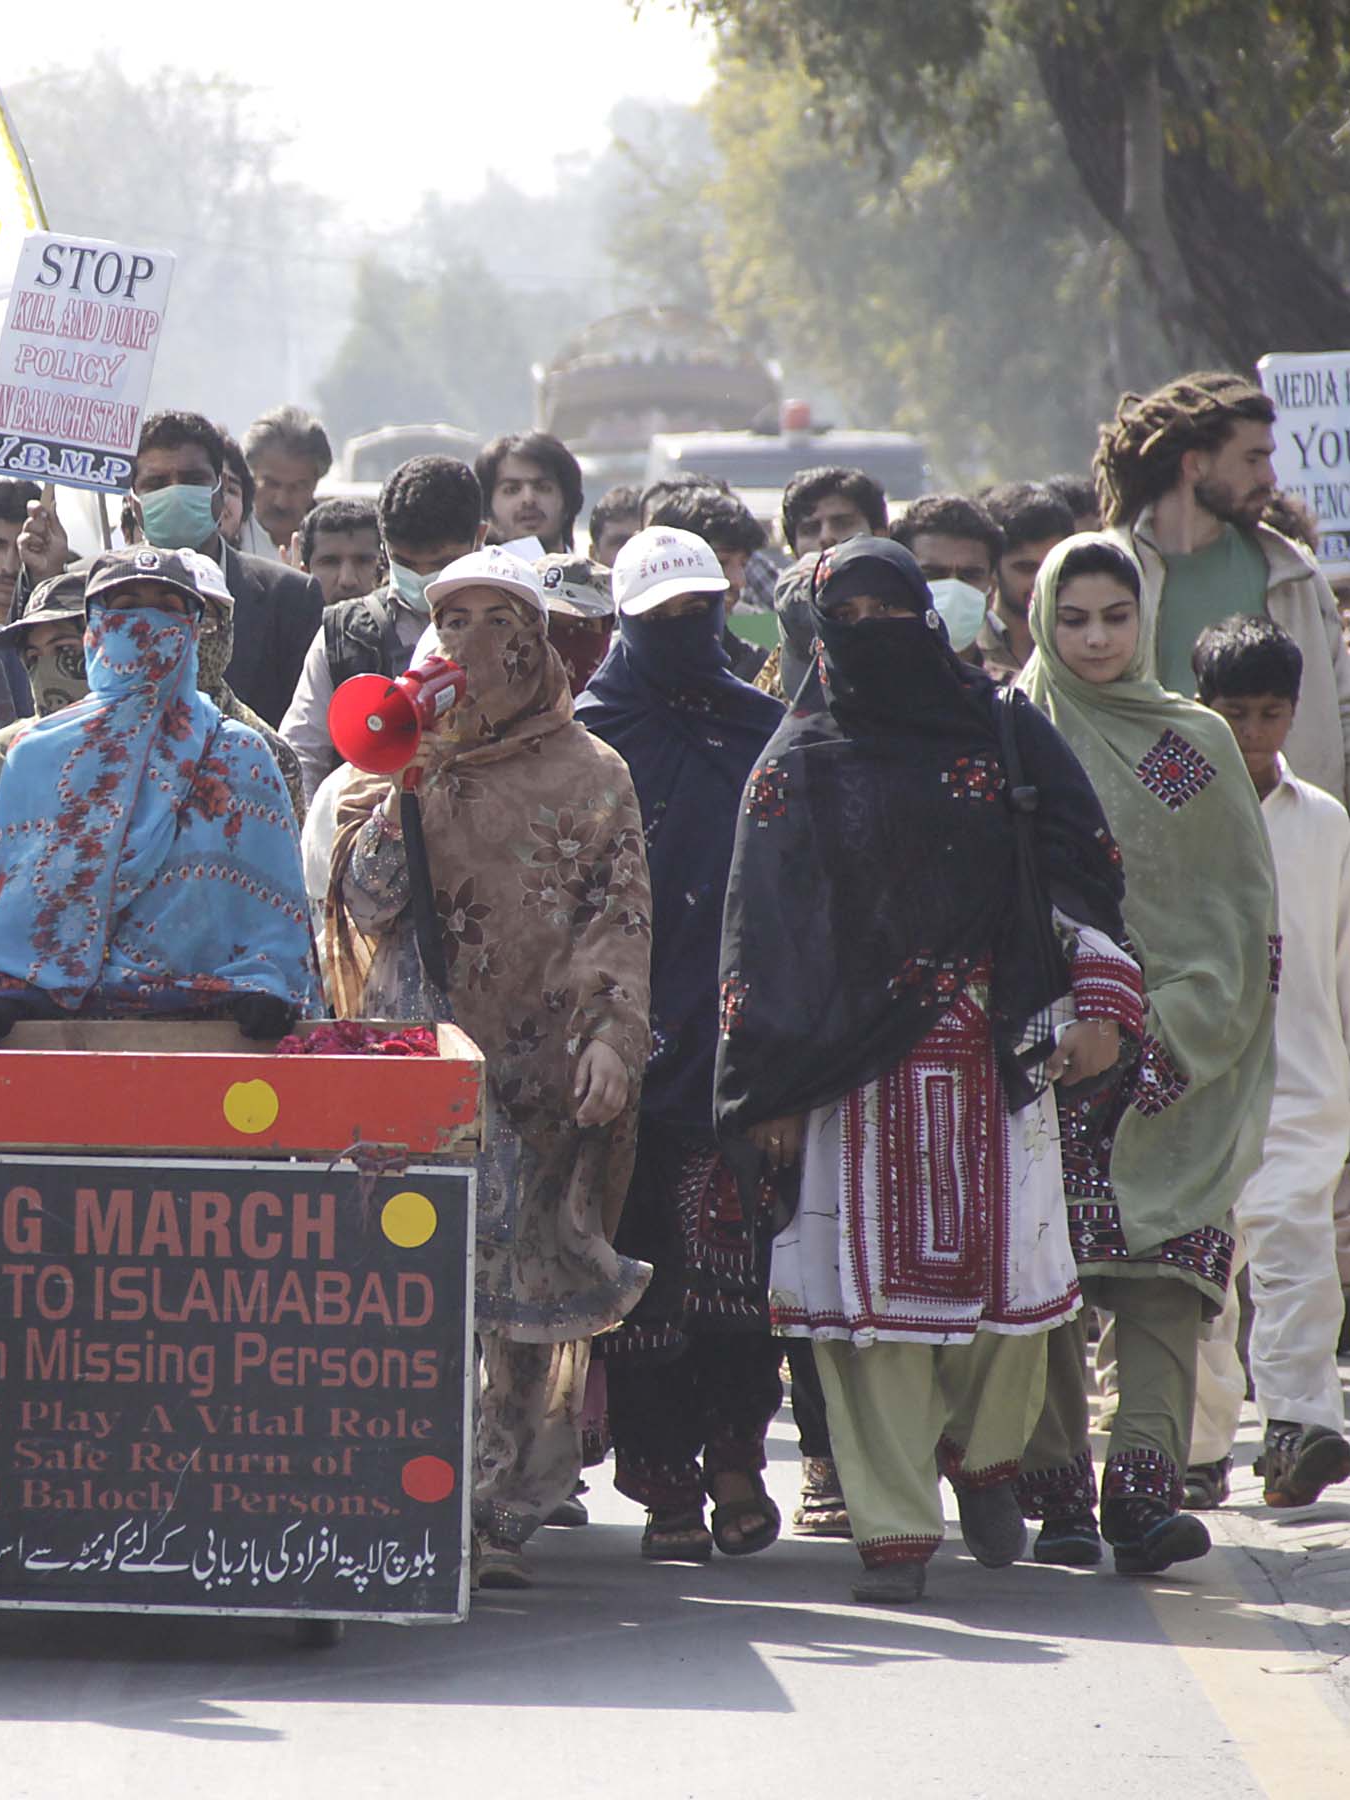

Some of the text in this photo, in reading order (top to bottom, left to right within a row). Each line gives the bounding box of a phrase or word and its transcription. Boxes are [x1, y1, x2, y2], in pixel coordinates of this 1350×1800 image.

[34, 243, 155, 302] STOP
[10, 290, 161, 352] KILL AND DUMP
[14, 343, 127, 389] POLICY
[1274, 369, 1340, 409] MEDIA
[10, 387, 140, 450] BALOCHISTAN
[73, 1188, 337, 1260] MARCH
[1, 1264, 75, 1321] TO
[93, 1265, 435, 1327] ISLAMABAD
[25, 1326, 216, 1398] Missing
[234, 1331, 439, 1388] Persons
[20, 1400, 121, 1438] Play
[142, 1403, 175, 1434] A
[197, 1404, 306, 1437] Vital
[328, 1407, 435, 1440] Role
[12, 1439, 109, 1472] Safe
[129, 1441, 291, 1475] Return
[311, 1446, 361, 1477] of
[21, 1478, 178, 1514] Baloch
[211, 1481, 402, 1517] Persons.
[192, 1528, 263, 1592] بازیابی
[264, 1519, 303, 1583] کی
[291, 1526, 339, 1584] افراد
[382, 1527, 437, 1587] بلوچ
